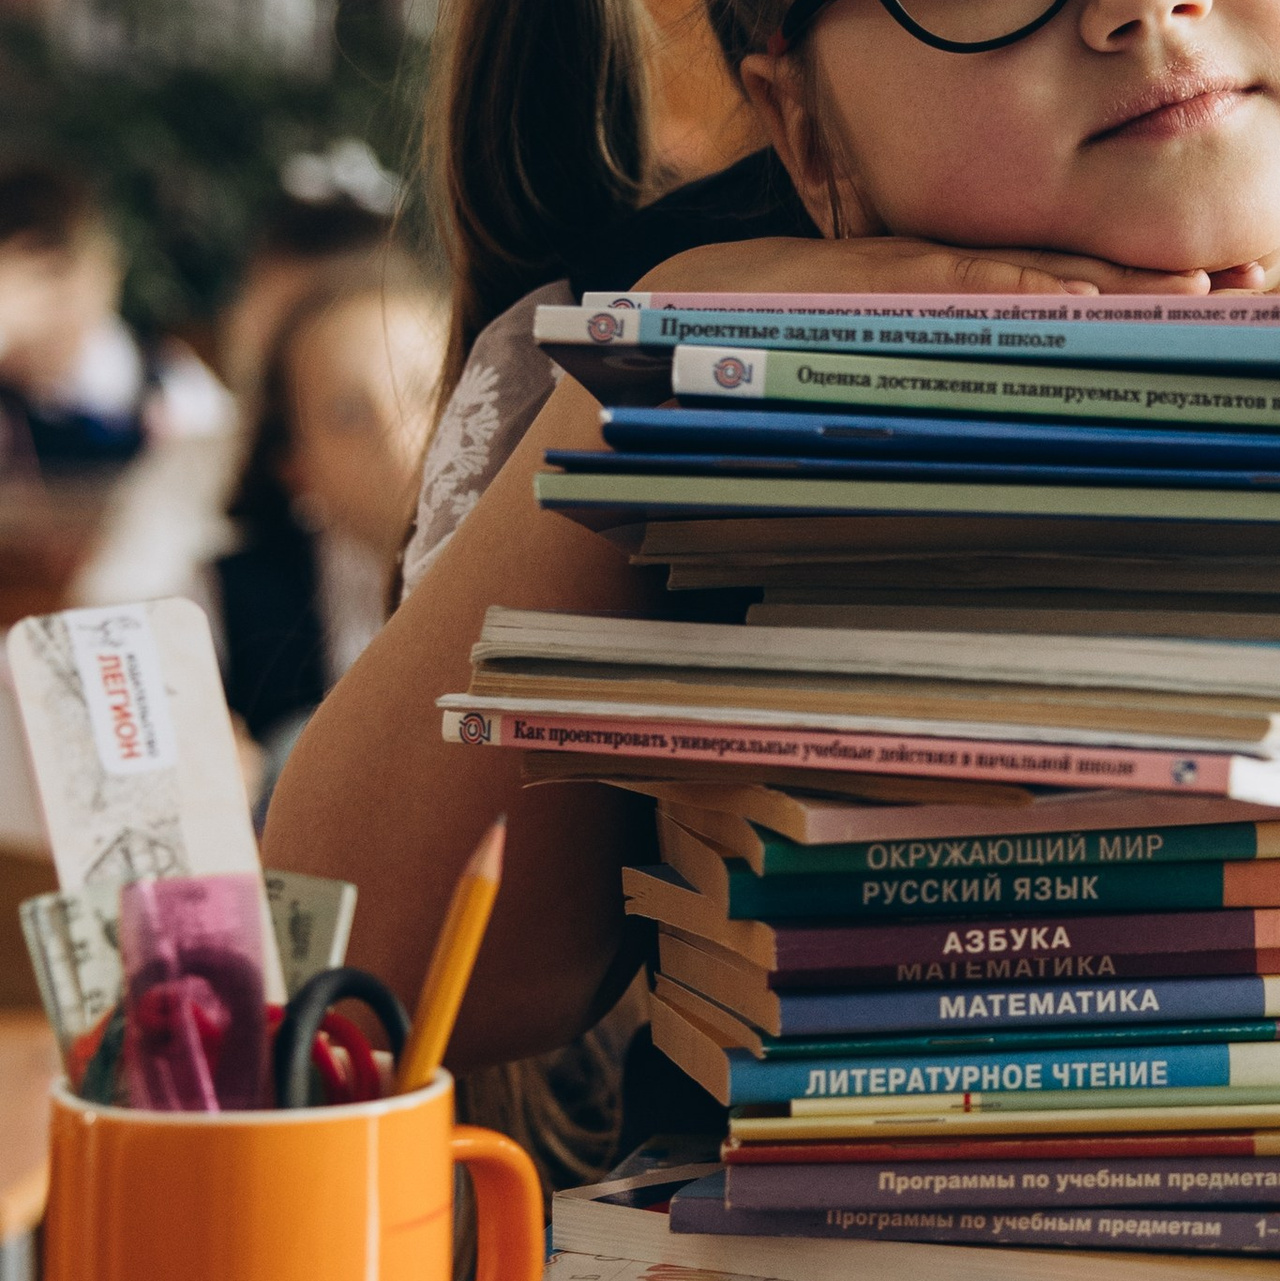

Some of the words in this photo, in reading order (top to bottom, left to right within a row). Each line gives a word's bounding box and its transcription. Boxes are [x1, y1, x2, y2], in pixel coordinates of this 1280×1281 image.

[994, 304, 1068, 321] действий
[1073, 309, 1083, 320] в
[1086, 305, 1162, 321] основной
[1167, 308, 1226, 322] школе:
[1229, 308, 1247, 321] от
[660, 318, 779, 341] Проектные
[783, 325, 857, 345] задачи
[862, 327, 874, 343] в
[879, 326, 992, 347] начальной
[998, 332, 1066, 349] школе
[797, 365, 871, 387] Оценка
[876, 375, 997, 395] достижения
[1002, 381, 1140, 404] планируемых
[1146, 389, 1267, 410] результатов
[97, 653, 142, 760] ЛЕГИОН
[513, 719, 546, 741] Как
[549, 726, 667, 752] проектировать
[672, 734, 797, 757] универсальные
[802, 739, 873, 762] учебные
[879, 747, 955, 766] действия
[961, 752, 970, 766] в
[976, 752, 1071, 773] начальной
[867, 831, 1088, 870] ОКРУЖАЮЩИЙ
[1100, 833, 1164, 861] МИР
[862, 873, 1001, 905] РУССКИЙ
[1014, 875, 1099, 901] ЯЗЫК
[942, 926, 1071, 955] АЗБУКА
[897, 955, 1117, 982] МАТЕМАТИКА
[939, 989, 1160, 1020] МАТЕМАТИКА
[804, 1064, 1043, 1097] ЛИТЕРАТУРНОЕ
[1052, 1060, 1169, 1089] ЧТЕНИЕ
[878, 1170, 1014, 1195] Программы
[1022, 1174, 1049, 1189] по
[1056, 1170, 1160, 1193] учебным
[826, 1209, 954, 1230] Программы
[960, 1214, 987, 1229] по
[992, 1213, 1092, 1235] учебным
[1097, 1216, 1221, 1238] предметам
